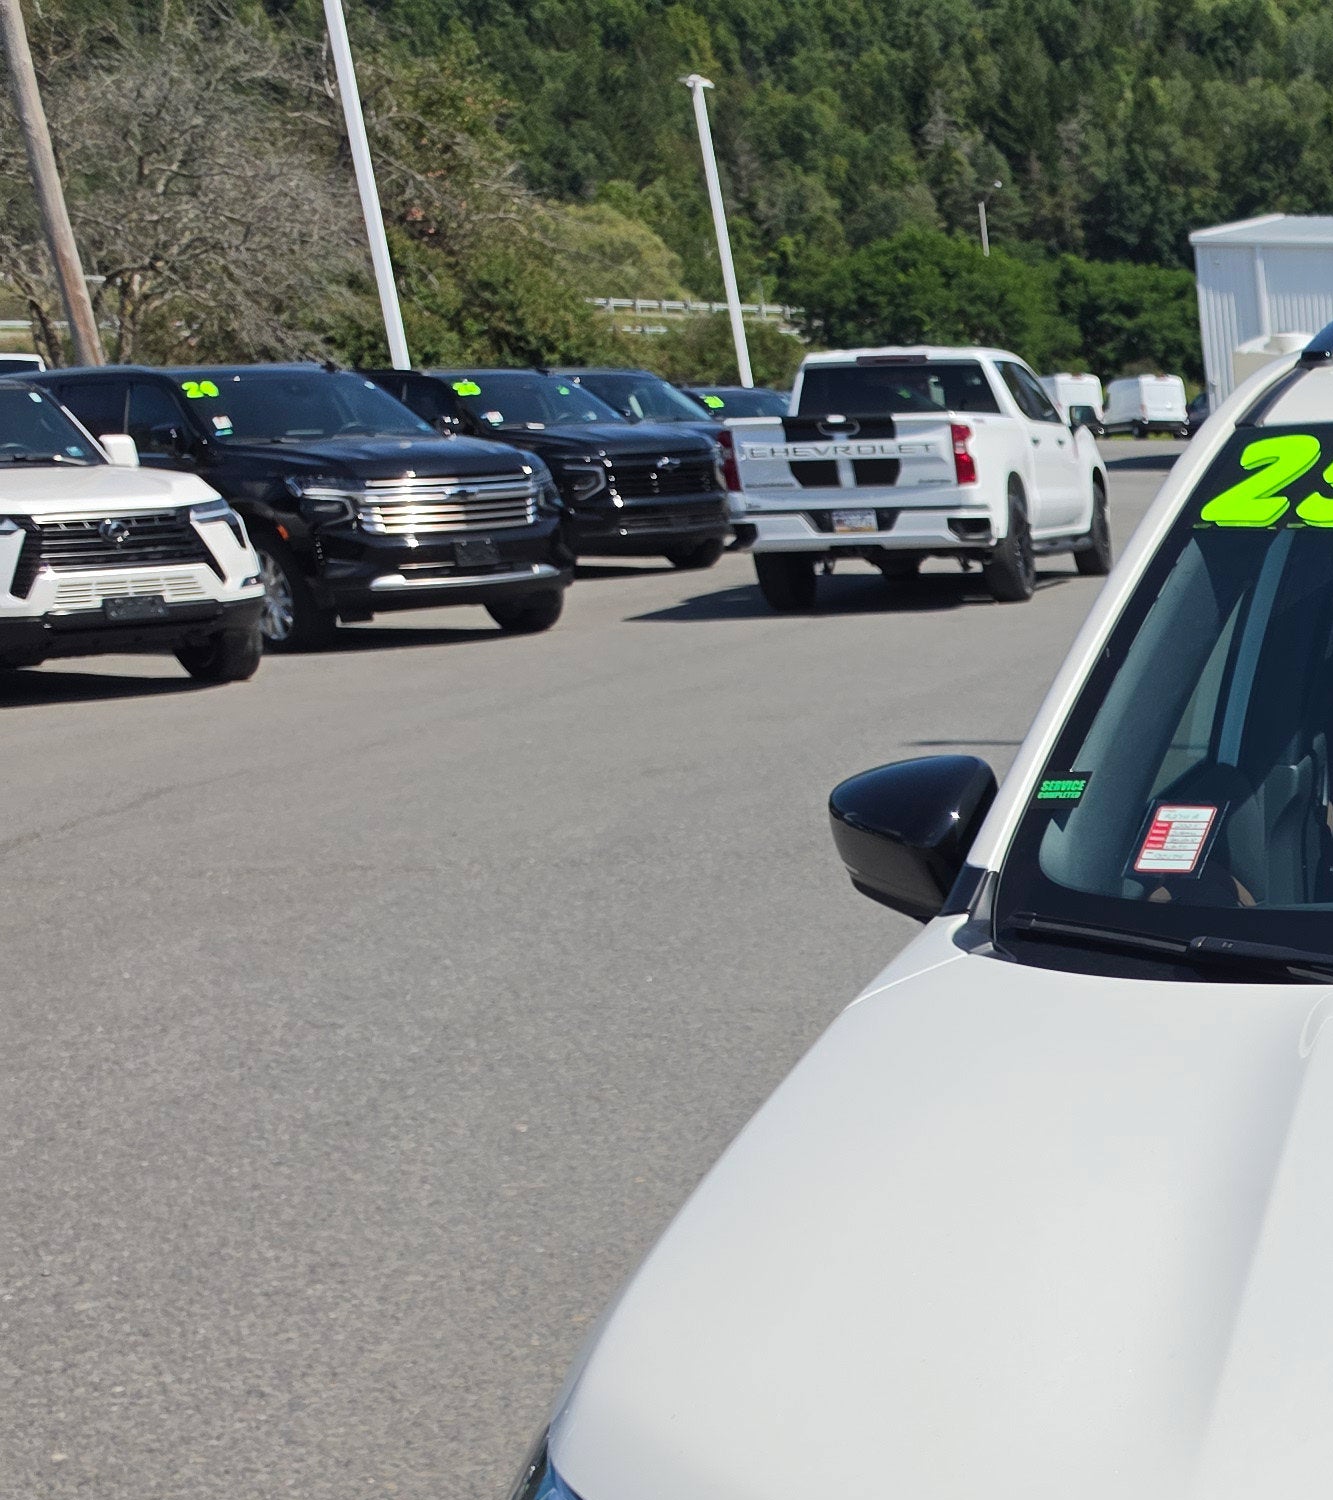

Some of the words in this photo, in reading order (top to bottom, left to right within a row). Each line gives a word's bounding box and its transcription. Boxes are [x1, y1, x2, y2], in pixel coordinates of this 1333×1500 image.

[750, 444, 934, 459] CHEVROLET
[1041, 780, 1086, 791] SERVICE
[1037, 791, 1081, 799] COMPLETED
